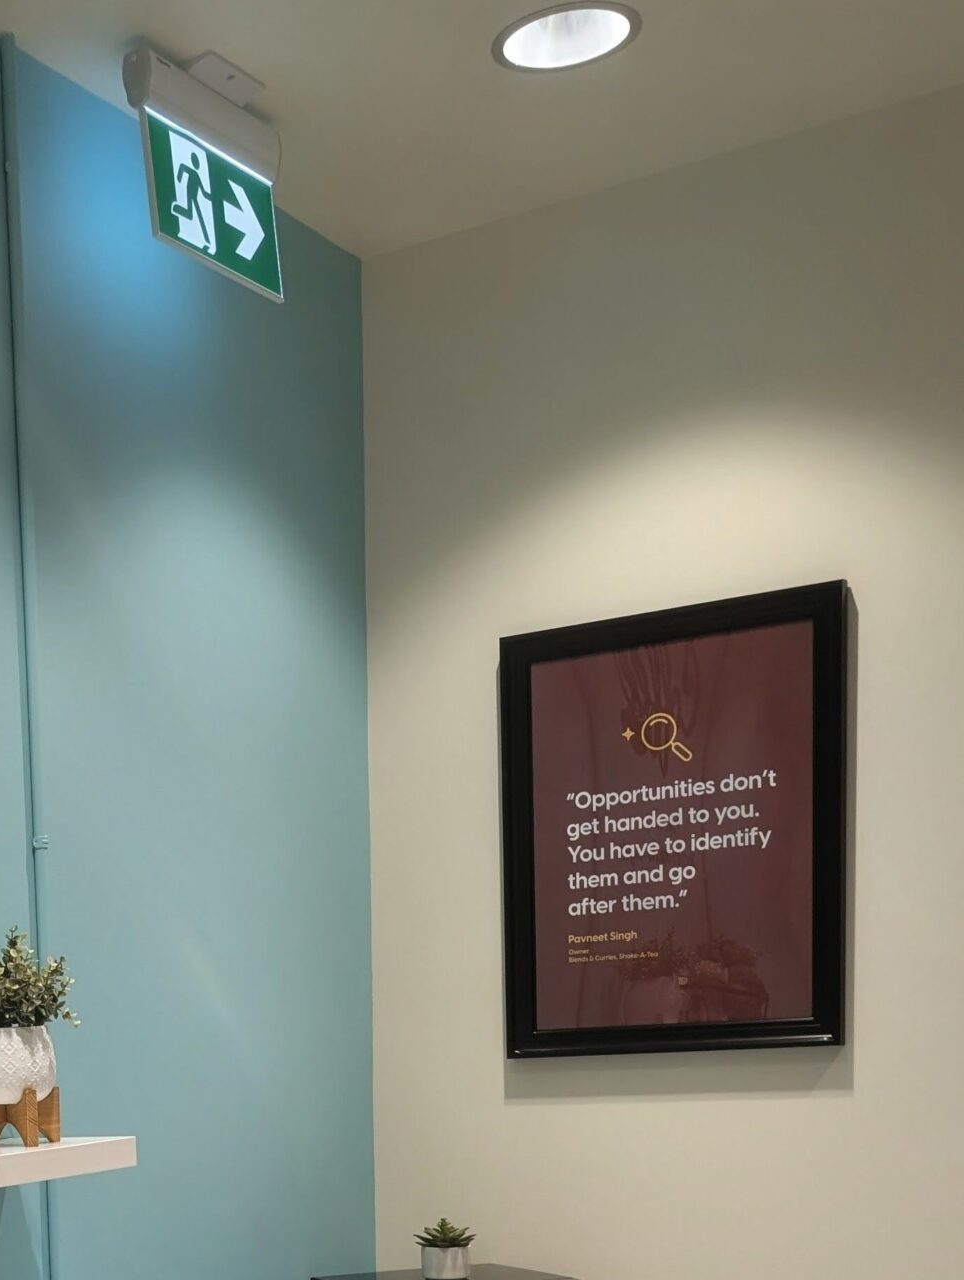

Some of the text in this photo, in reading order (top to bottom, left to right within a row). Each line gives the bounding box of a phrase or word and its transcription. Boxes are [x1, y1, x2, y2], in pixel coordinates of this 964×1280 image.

[567, 769, 777, 811] “Opportunities don’t
[567, 804, 760, 841] get handed to you.
[568, 827, 772, 863] You have to identify
[568, 865, 696, 889] them and go
[568, 889, 688, 916] after them.”
[568, 930, 638, 944] Pavneet Singh
